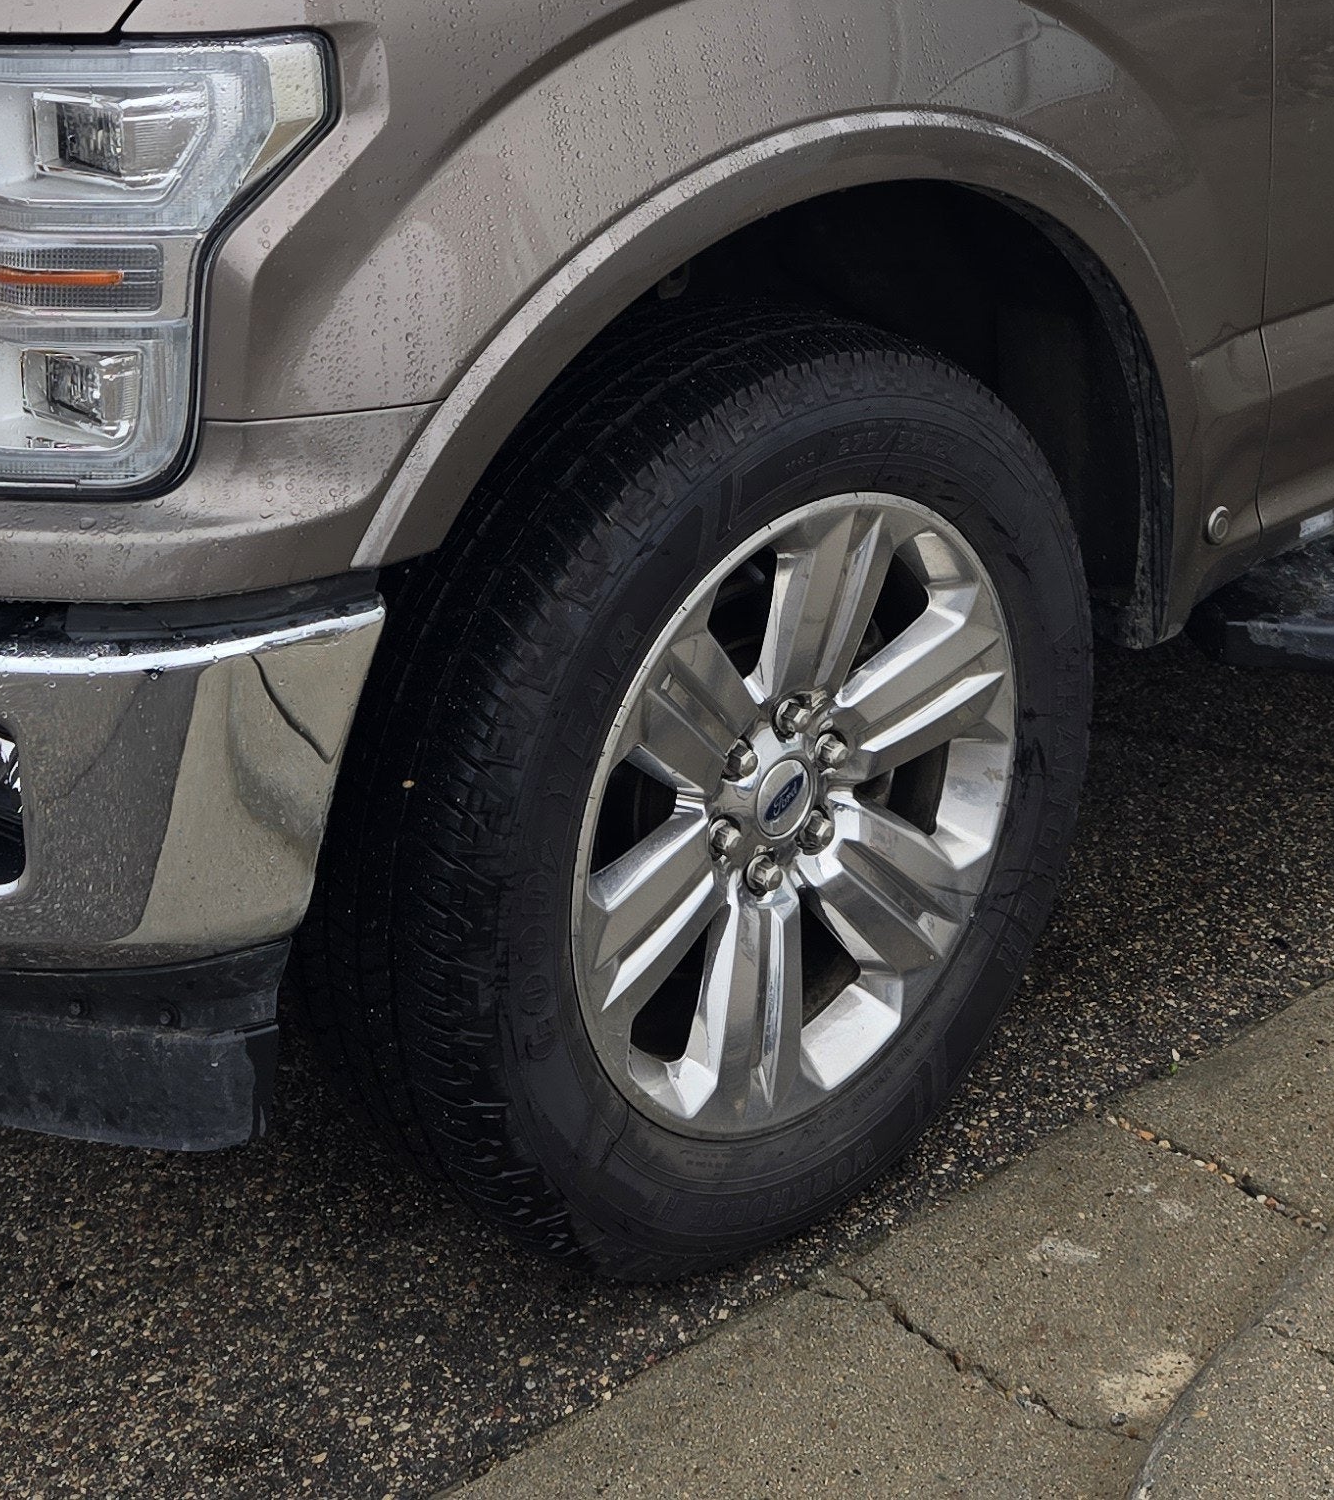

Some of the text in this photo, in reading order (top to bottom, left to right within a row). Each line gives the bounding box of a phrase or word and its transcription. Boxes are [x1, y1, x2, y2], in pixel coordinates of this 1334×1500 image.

[517, 612, 645, 1063] GOODYEAR
[773, 780, 798, 817] Ford
[996, 622, 1081, 977] WRANGLER
[694, 1138, 877, 1228] WORKHORSE
